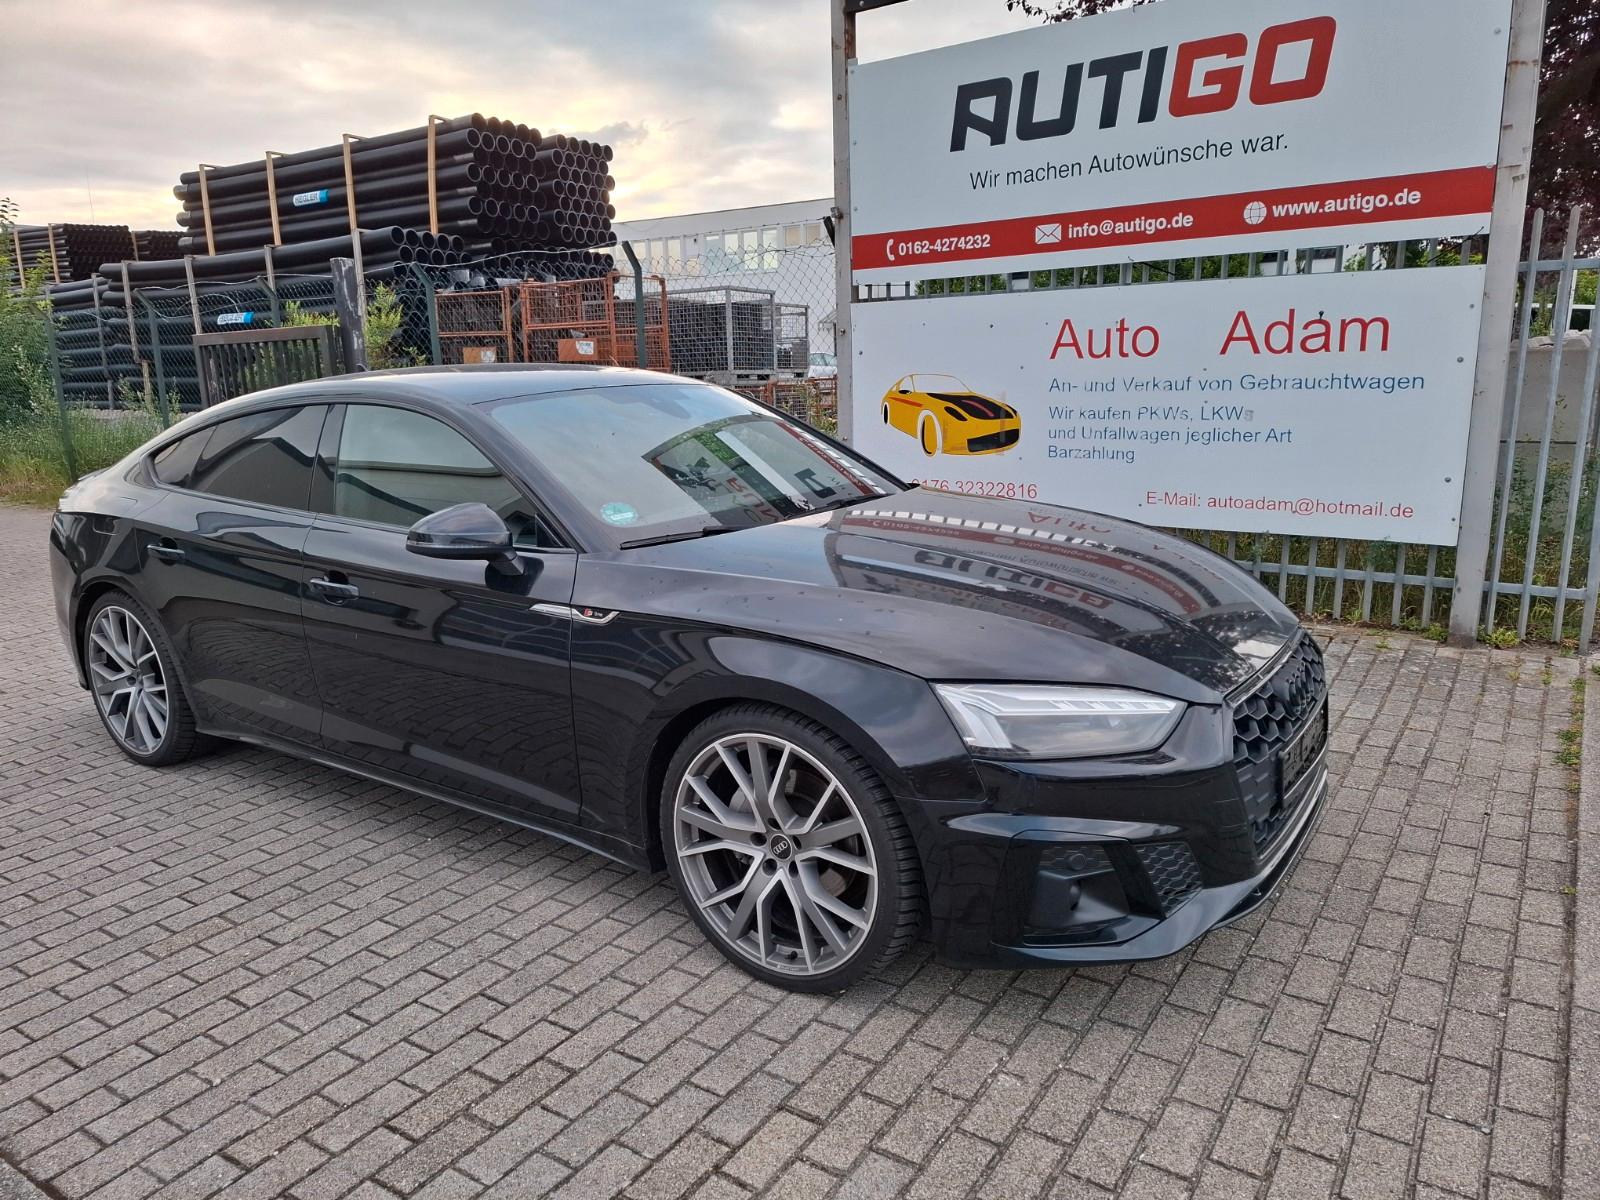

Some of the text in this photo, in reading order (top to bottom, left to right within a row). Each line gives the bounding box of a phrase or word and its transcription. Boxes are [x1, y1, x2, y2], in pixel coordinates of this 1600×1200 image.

[951, 15, 1337, 152] AUTIGO
[970, 132, 1288, 190] Wir machen Autowünsche war.
[1272, 188, 1422, 217] www.autigo.de
[1068, 212, 1194, 239] info@autigo.de
[898, 234, 991, 256] 0162-4274232
[1049, 308, 1391, 360] Auto Adam
[1049, 374, 1425, 394] An- und Verkauf von Gebrauchtwagen
[1048, 406, 1074, 420] Wir
[1079, 406, 1131, 420] kaufen
[1137, 406, 1193, 421] PKWs,
[1048, 427, 1293, 445] und Unfallwagen jeglicher Art
[1048, 445, 1135, 463] Barzahlung
[955, 481, 1037, 498] 32322816
[1146, 492, 1414, 518] E-Mail: autoadam@hotmail.de
